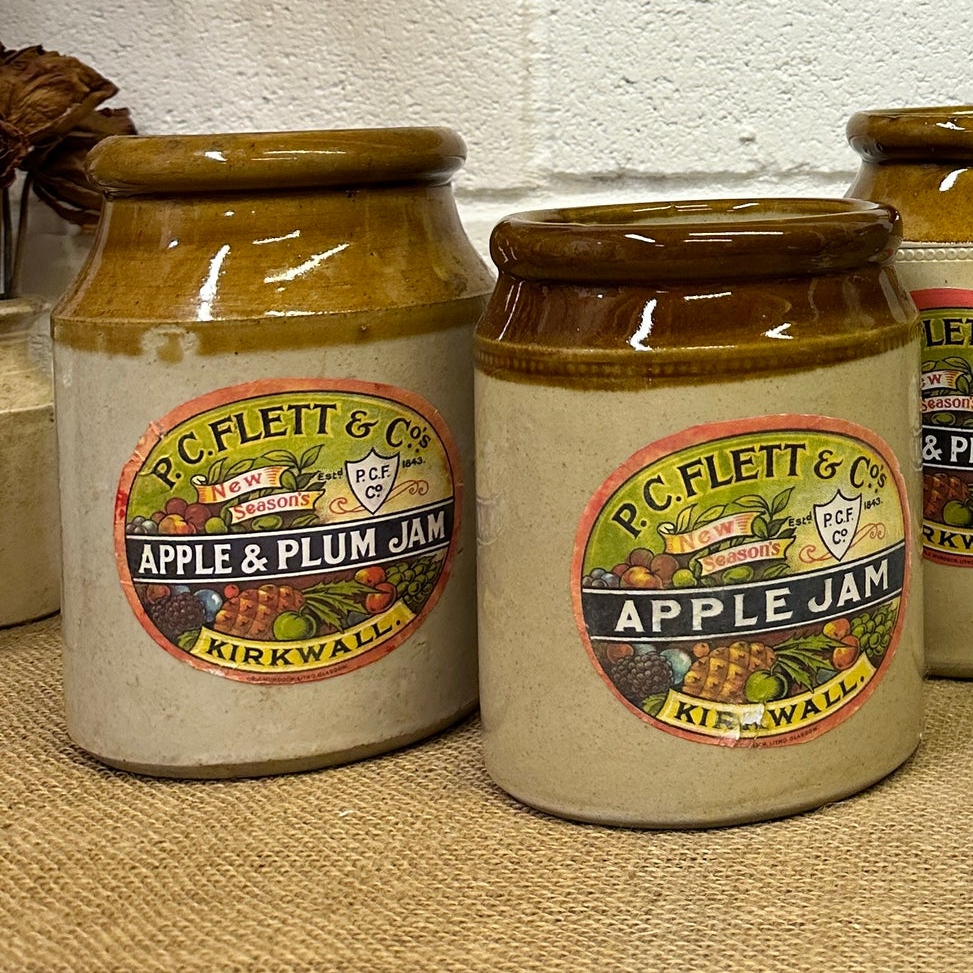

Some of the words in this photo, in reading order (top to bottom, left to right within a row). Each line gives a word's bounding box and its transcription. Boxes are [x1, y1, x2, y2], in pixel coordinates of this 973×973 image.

[345, 410, 379, 439] &
[923, 434, 943, 461] &
[814, 450, 844, 479] &
[211, 471, 263, 501] New
[234, 491, 311, 520] Season's
[138, 544, 232, 576] APPLE
[241, 544, 268, 574] &
[277, 527, 376, 571] PLUM
[388, 511, 447, 553] JAM
[679, 519, 736, 552] New
[702, 539, 781, 573] Season's
[614, 588, 794, 634] APPLE
[807, 559, 890, 613] JAM
